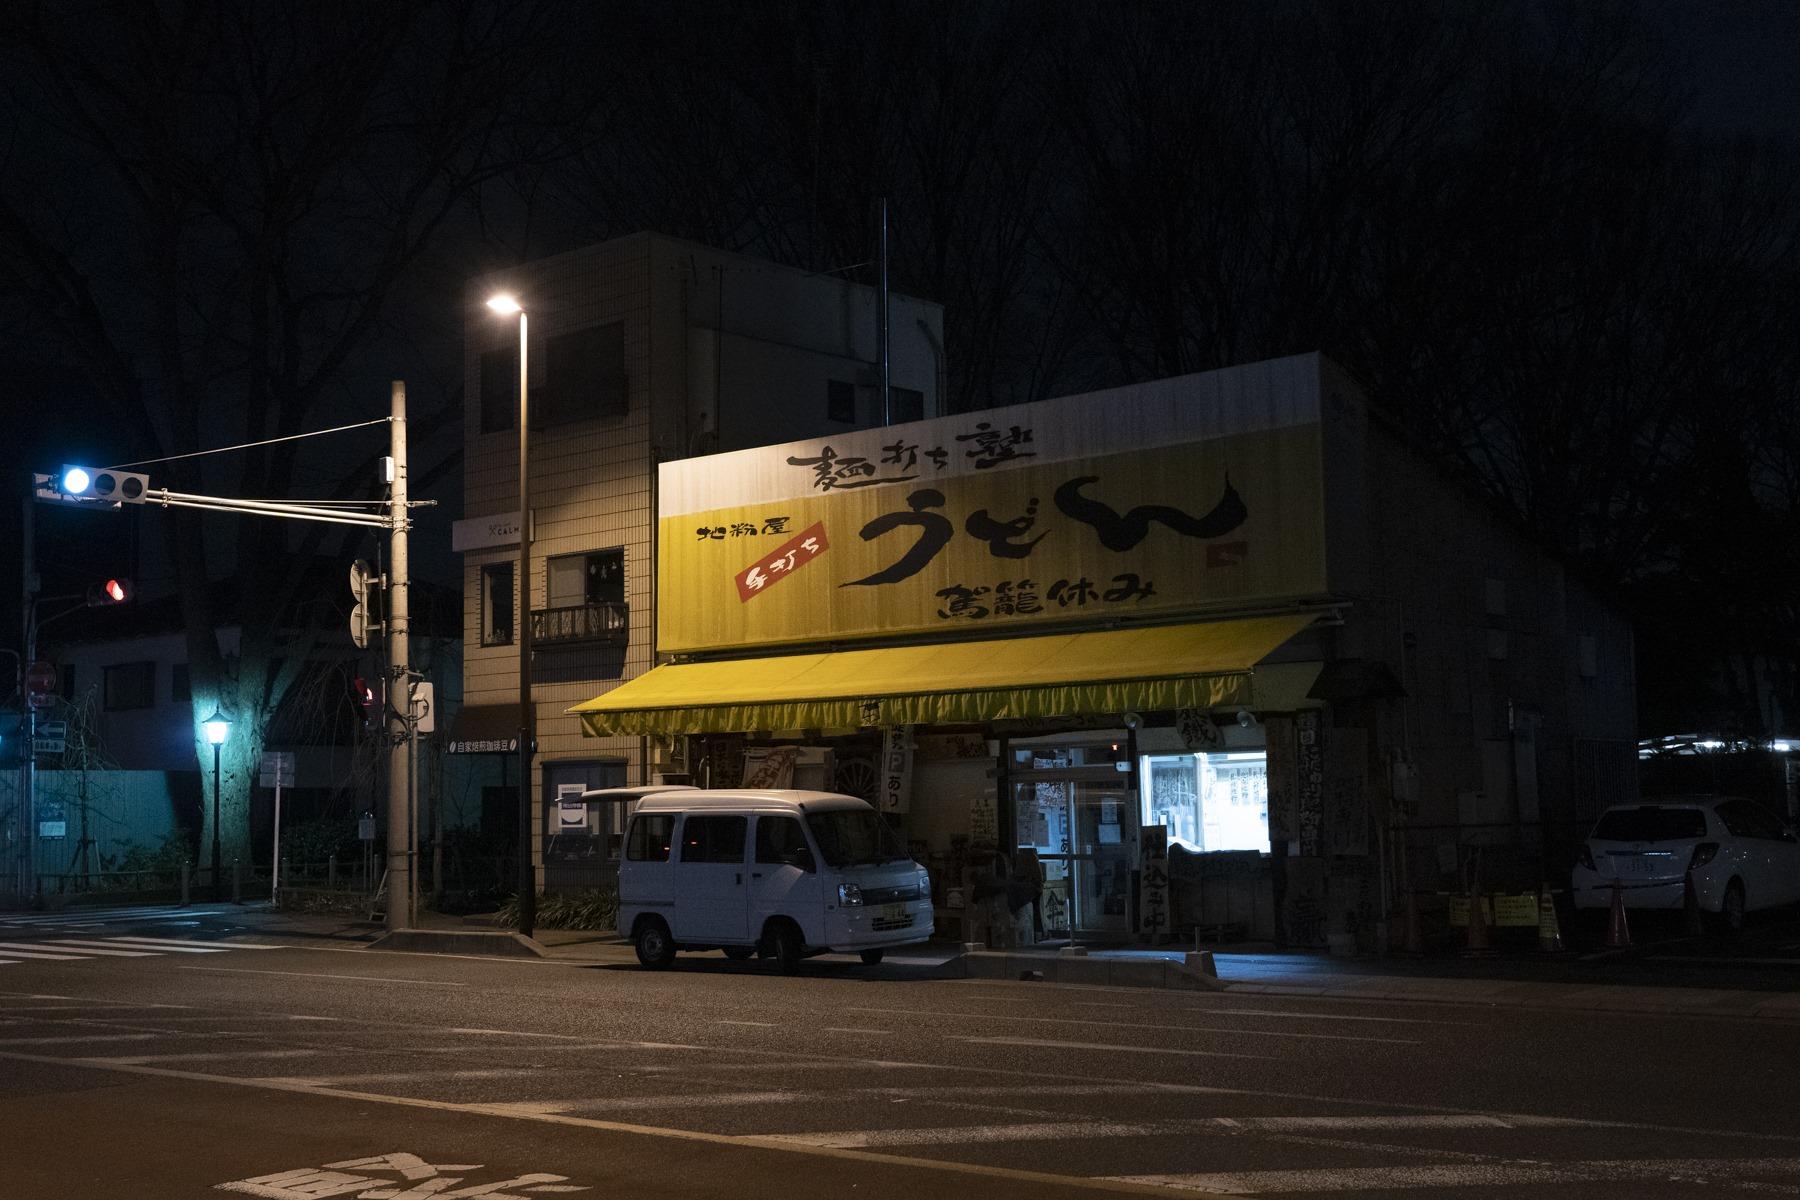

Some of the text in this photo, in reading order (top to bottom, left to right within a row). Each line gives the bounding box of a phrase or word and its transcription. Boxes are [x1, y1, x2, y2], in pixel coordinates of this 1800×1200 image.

[696, 516, 792, 541] 地粉屋
[839, 471, 1248, 588] うどん
[745, 537, 820, 591] 手打ち
[935, 573, 1157, 619] 駕籠休み
